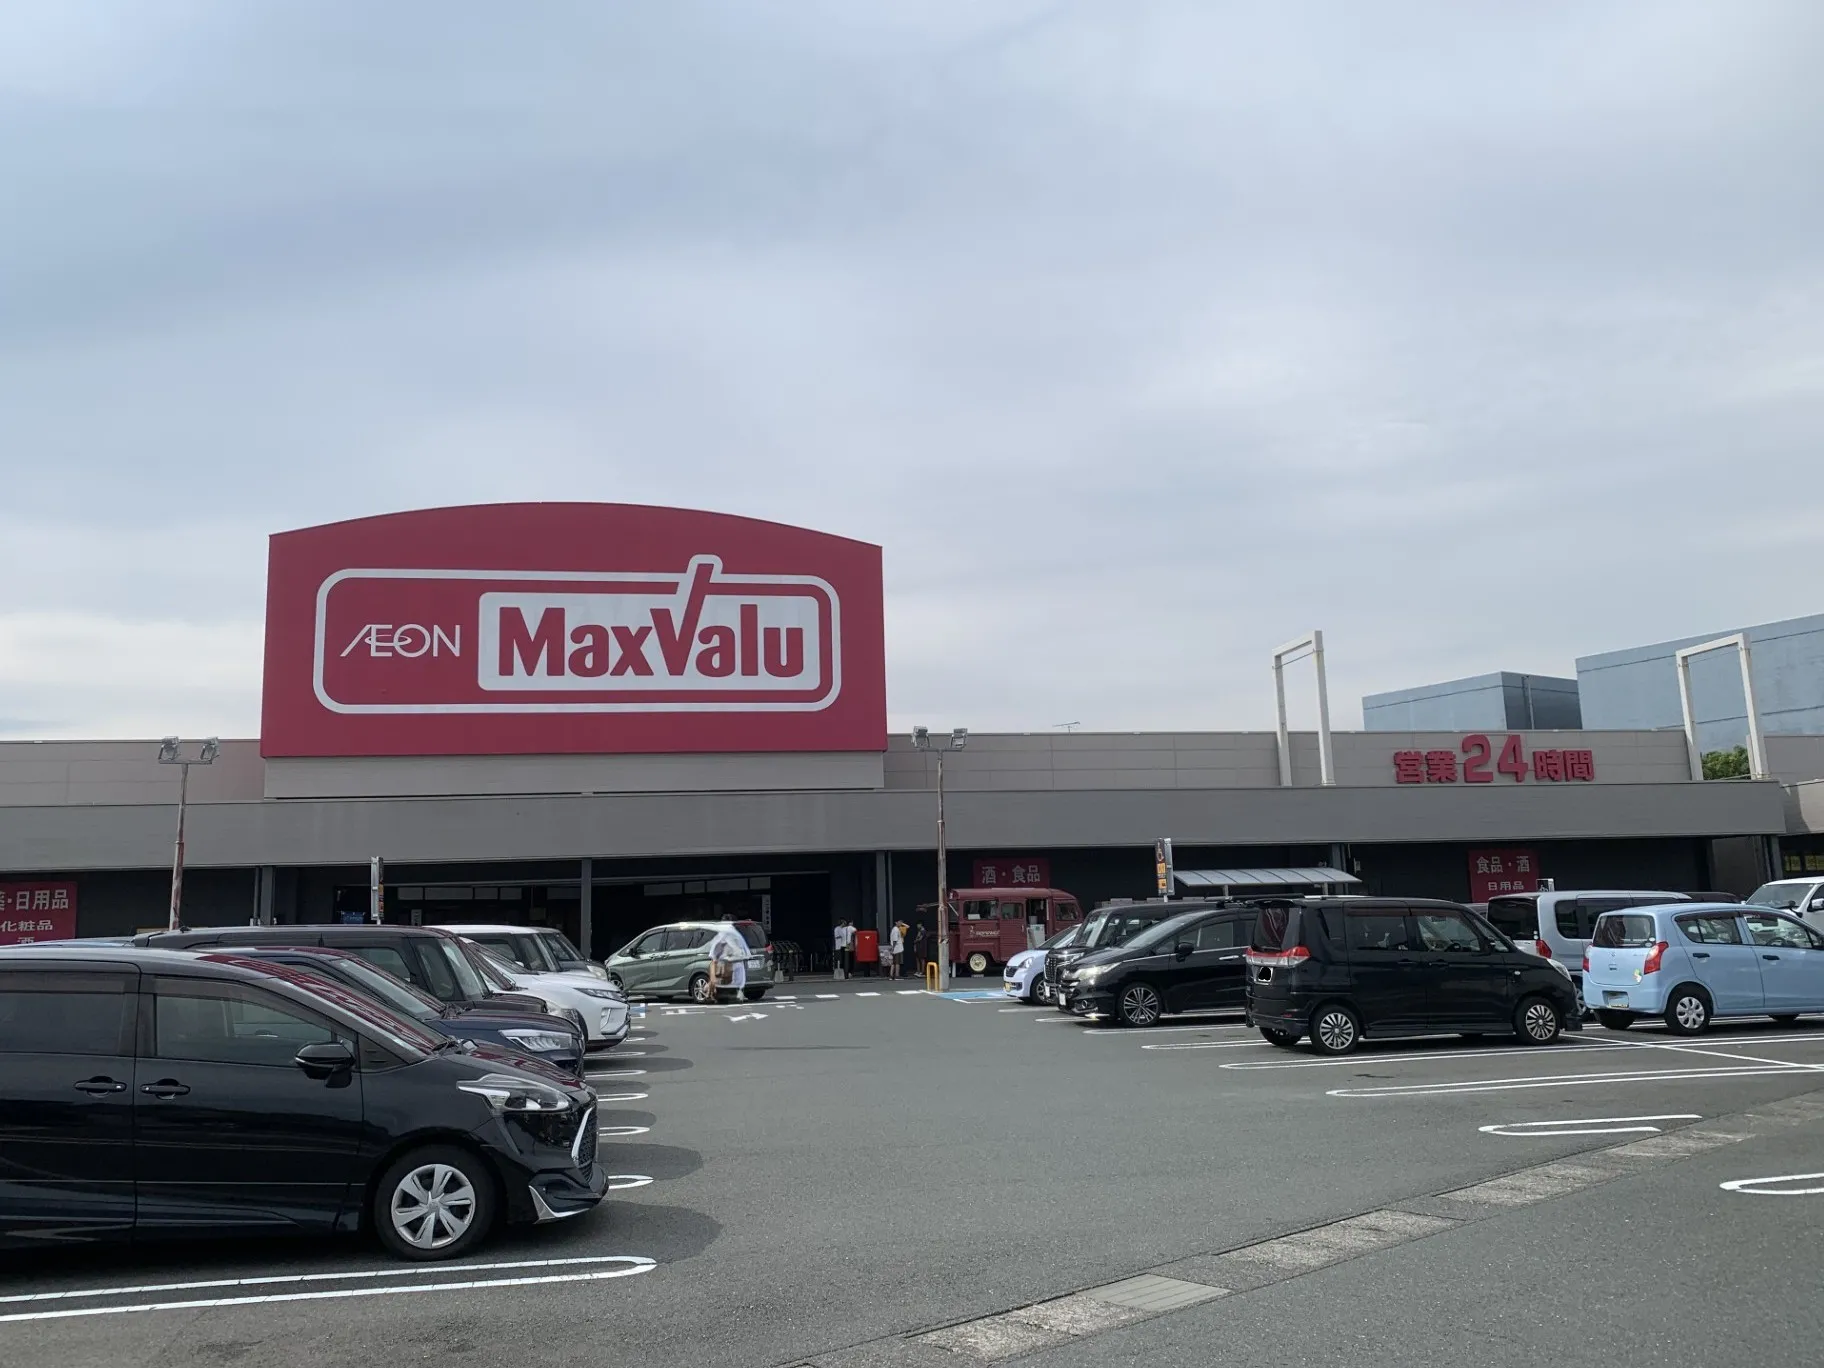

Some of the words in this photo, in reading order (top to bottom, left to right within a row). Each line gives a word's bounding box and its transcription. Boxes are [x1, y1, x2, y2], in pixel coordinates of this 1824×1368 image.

[498, 563, 804, 678] MaxValu
[1394, 734, 1595, 784] 営業24時間
[1488, 881, 1525, 891] 日用品
